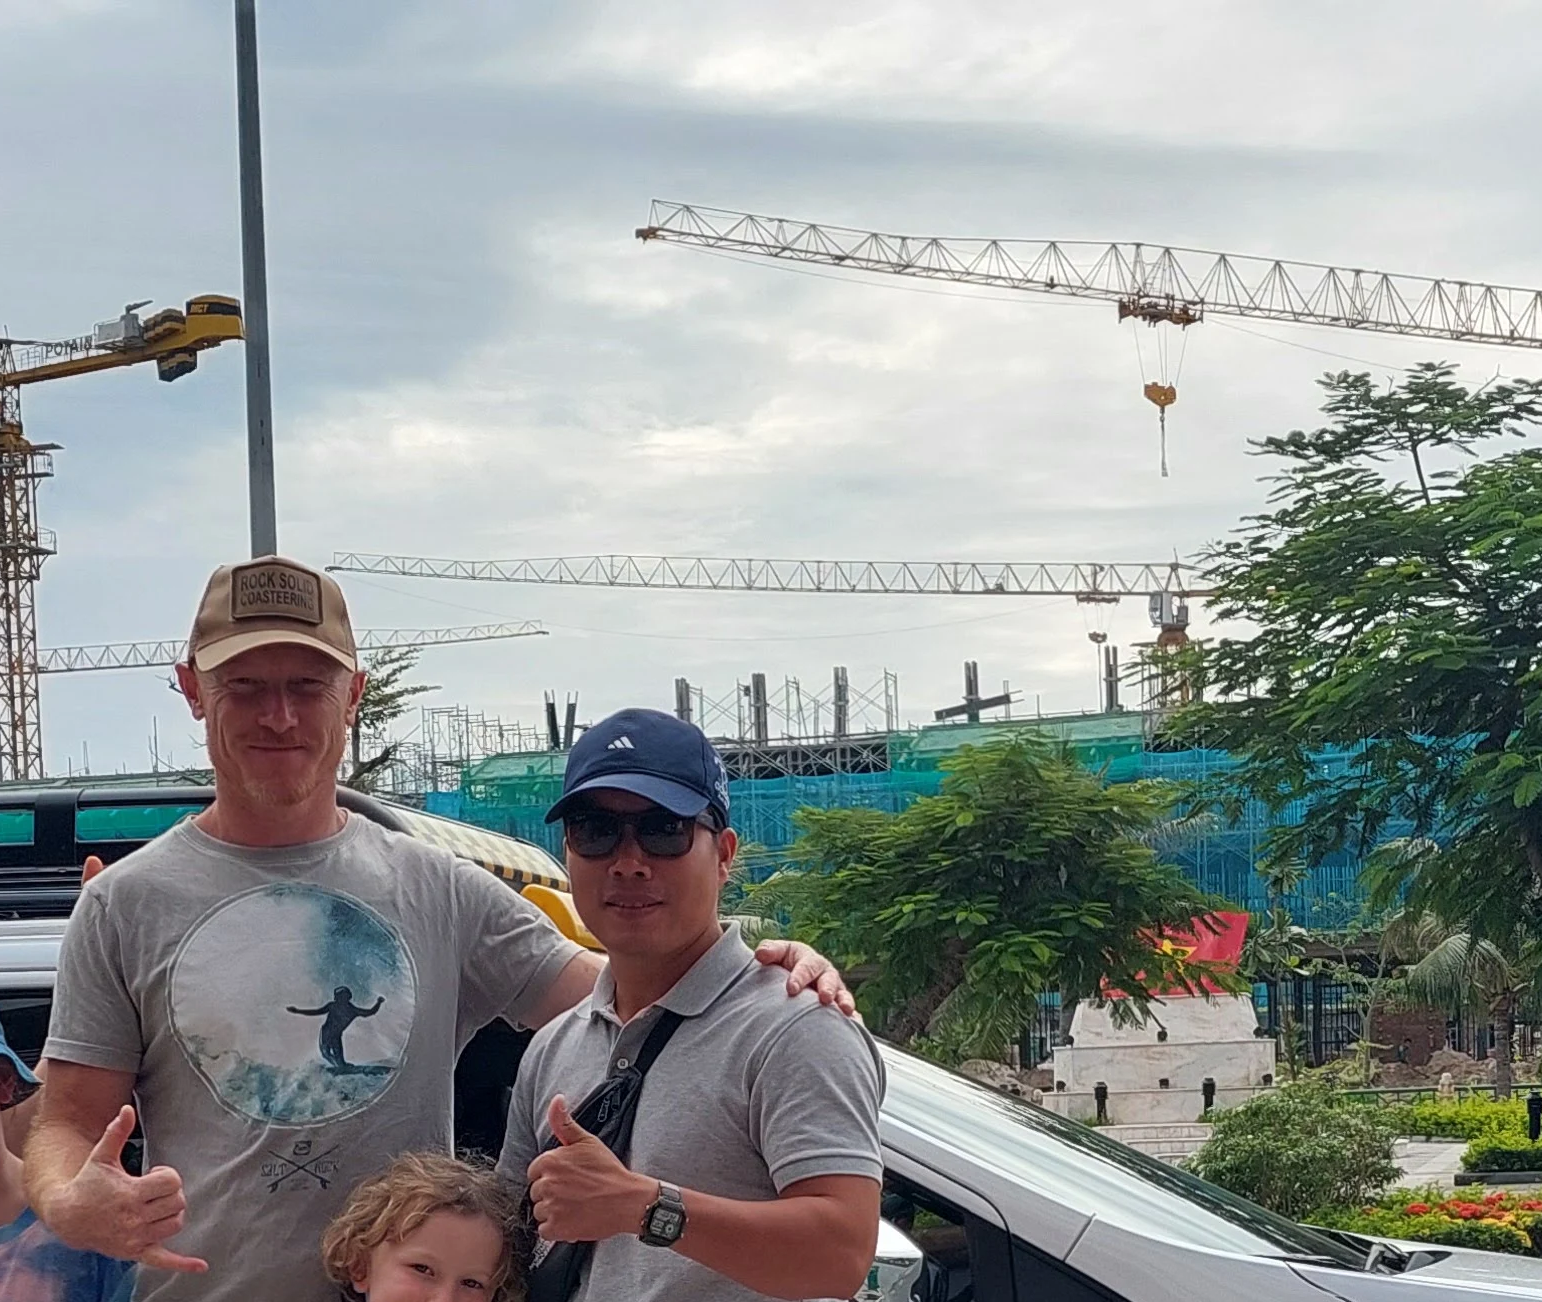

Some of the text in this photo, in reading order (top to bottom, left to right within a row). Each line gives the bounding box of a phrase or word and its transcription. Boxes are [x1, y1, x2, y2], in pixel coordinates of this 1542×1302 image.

[240, 572, 315, 595] ROCK SOLID
[240, 590, 315, 611] COASTEERING
